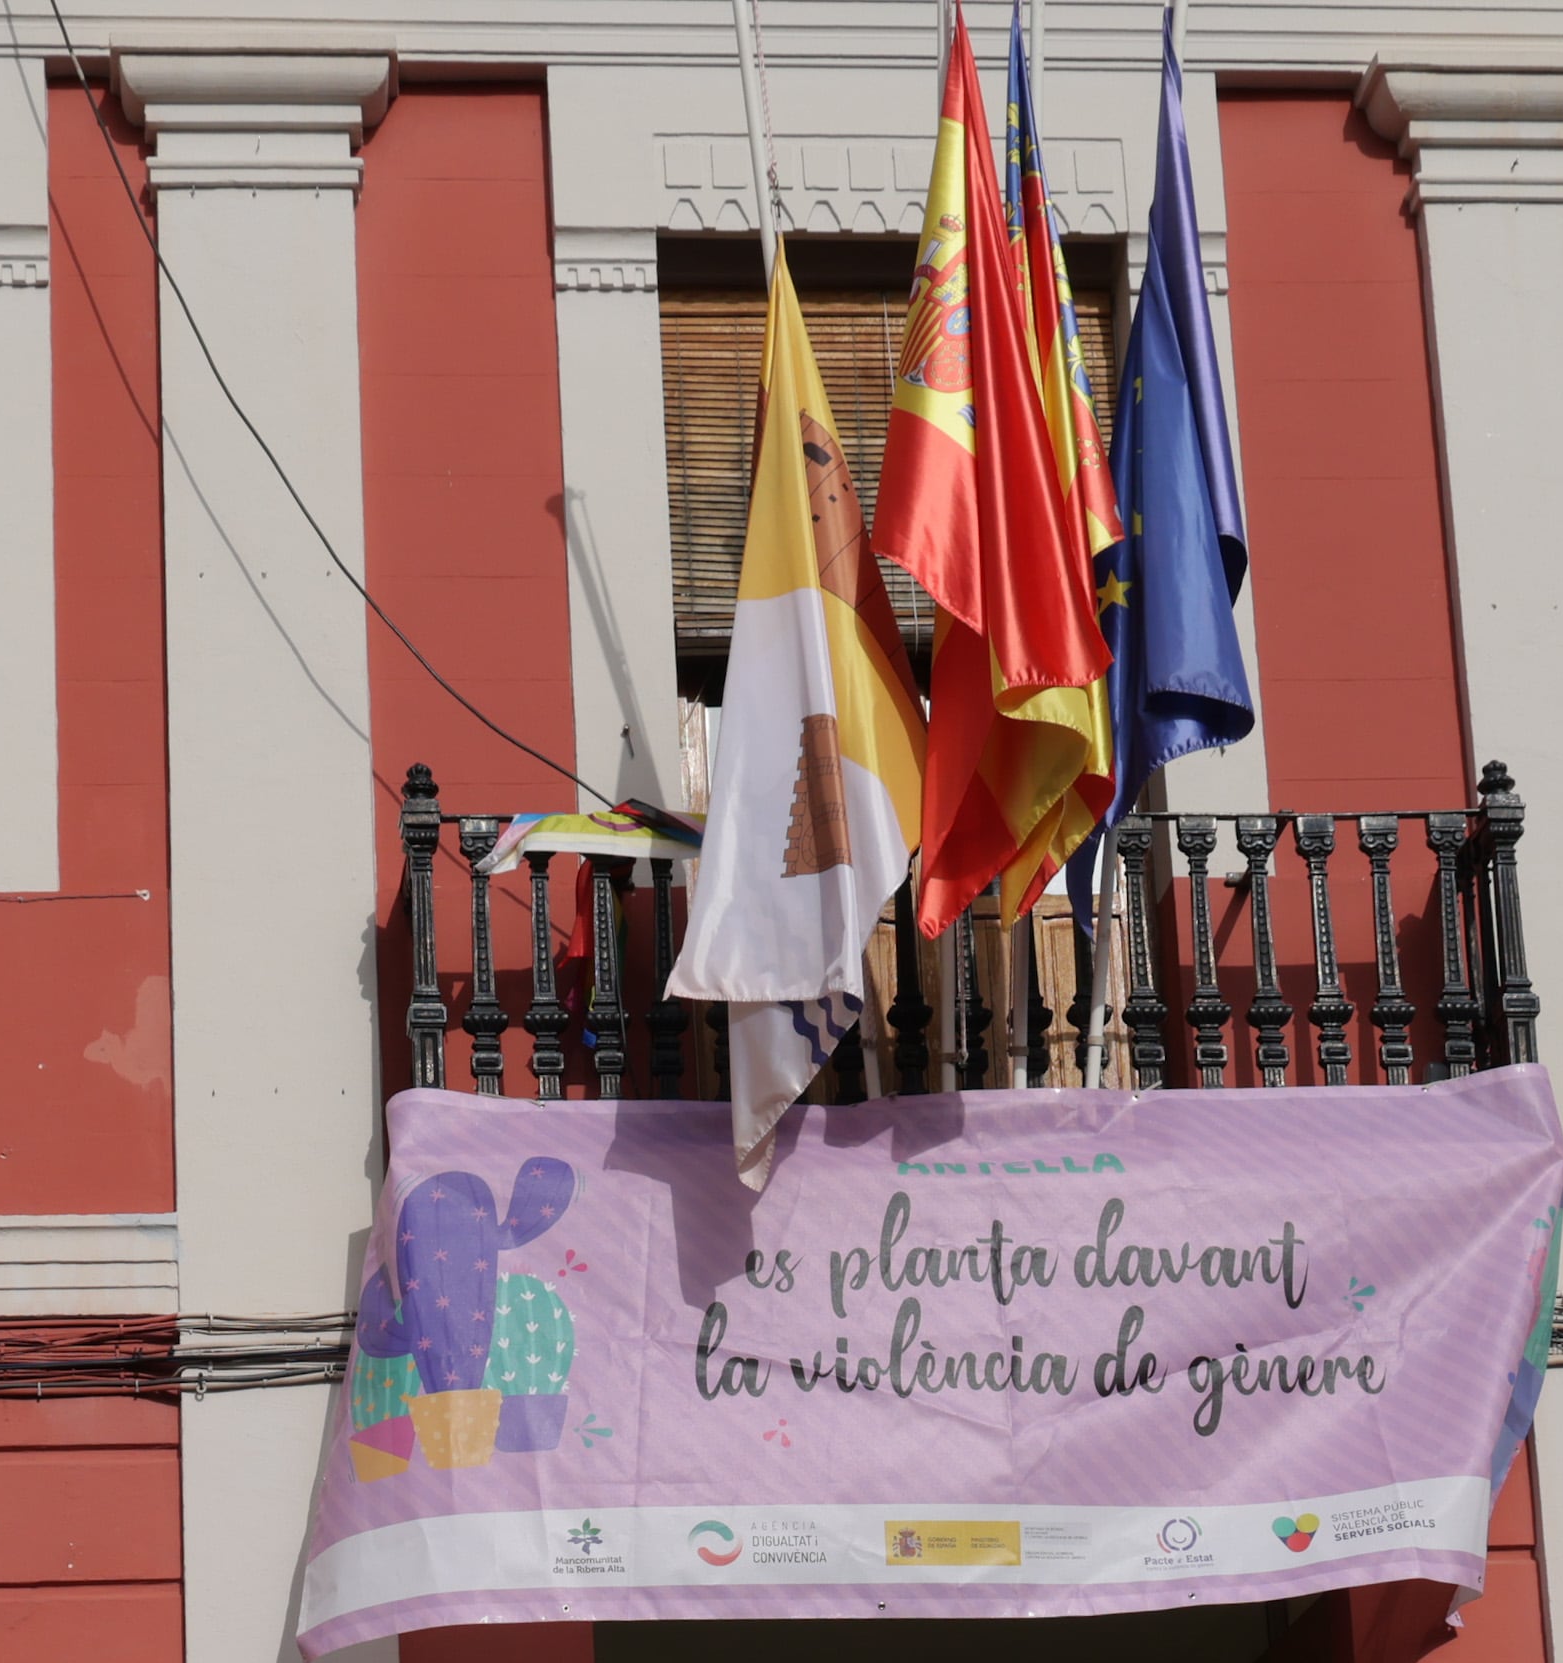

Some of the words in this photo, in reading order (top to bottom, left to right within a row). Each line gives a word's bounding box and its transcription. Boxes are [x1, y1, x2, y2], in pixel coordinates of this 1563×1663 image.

[745, 1248, 804, 1293] es
[829, 1191, 1059, 1319] planta
[1074, 1197, 1309, 1309] davant
[695, 1301, 772, 1401] la
[789, 1297, 1080, 1399] violència
[1093, 1305, 1169, 1398] de
[1187, 1342, 1386, 1437] gènere
[1331, 1506, 1381, 1522] SISTEMA
[1391, 1510, 1405, 1522] DE
[1334, 1525, 1384, 1541] SERVEIS
[1387, 1519, 1436, 1532] SOCIALS
[555, 1556, 622, 1565] Mancomunitat
[753, 1549, 827, 1563] CONVIVÈNCIA
[1144, 1556, 1174, 1565] Pacte
[607, 1564, 625, 1573] Alta
